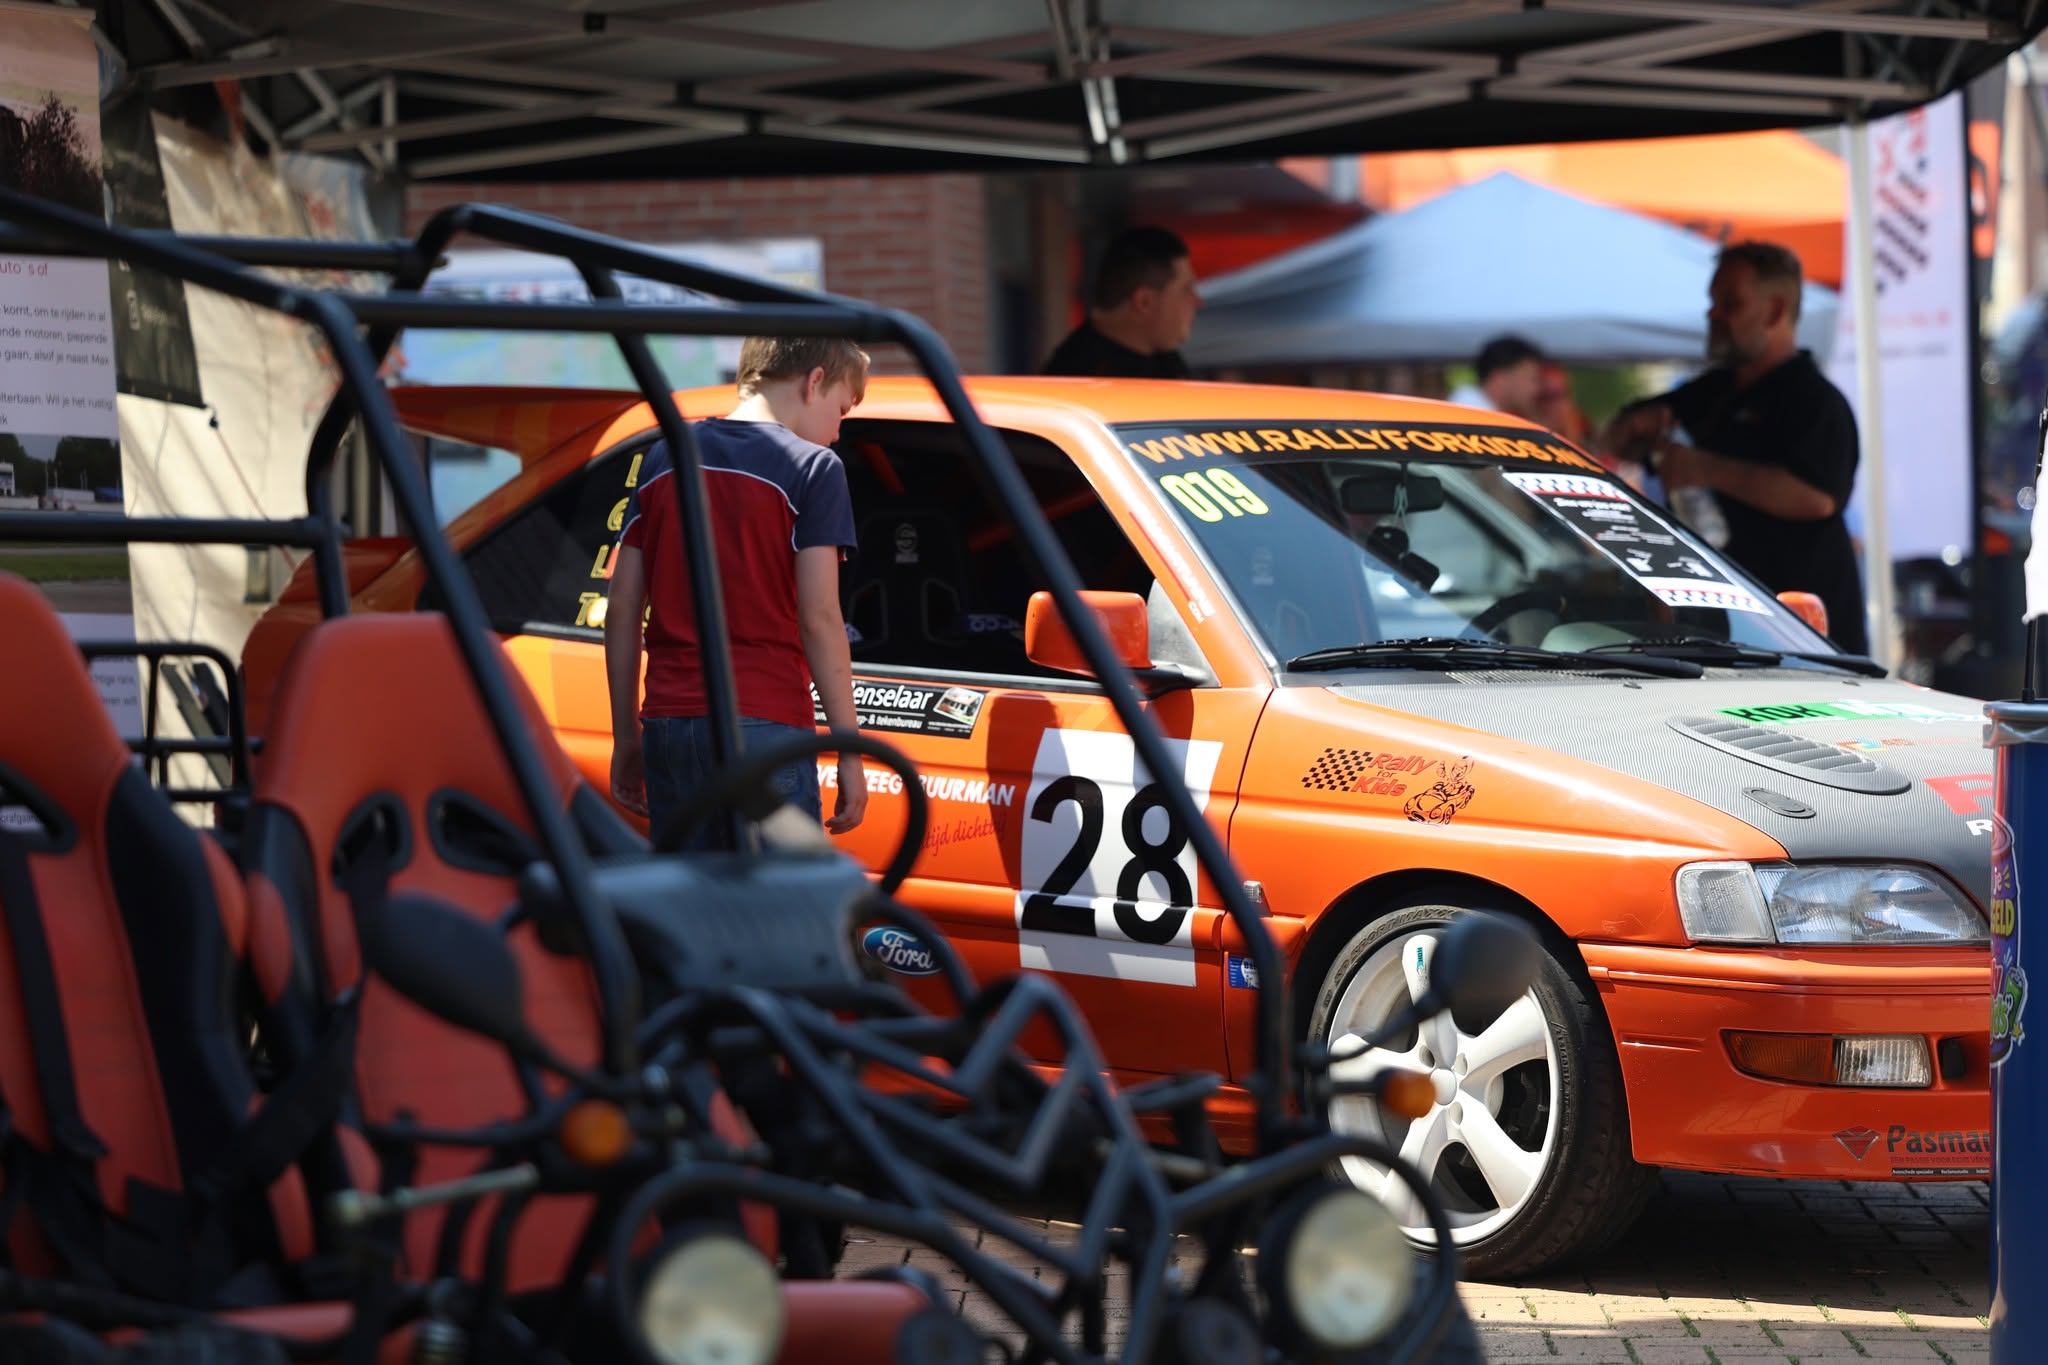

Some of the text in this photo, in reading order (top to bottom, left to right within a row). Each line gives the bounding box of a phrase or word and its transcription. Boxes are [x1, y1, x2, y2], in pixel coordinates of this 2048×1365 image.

[1159, 467, 1269, 523] 019
[1368, 753, 1438, 775] Rally
[1376, 769, 1397, 778] for
[1350, 776, 1408, 797] Kids
[1021, 775, 1193, 945] 28
[877, 931, 935, 969] Ford
